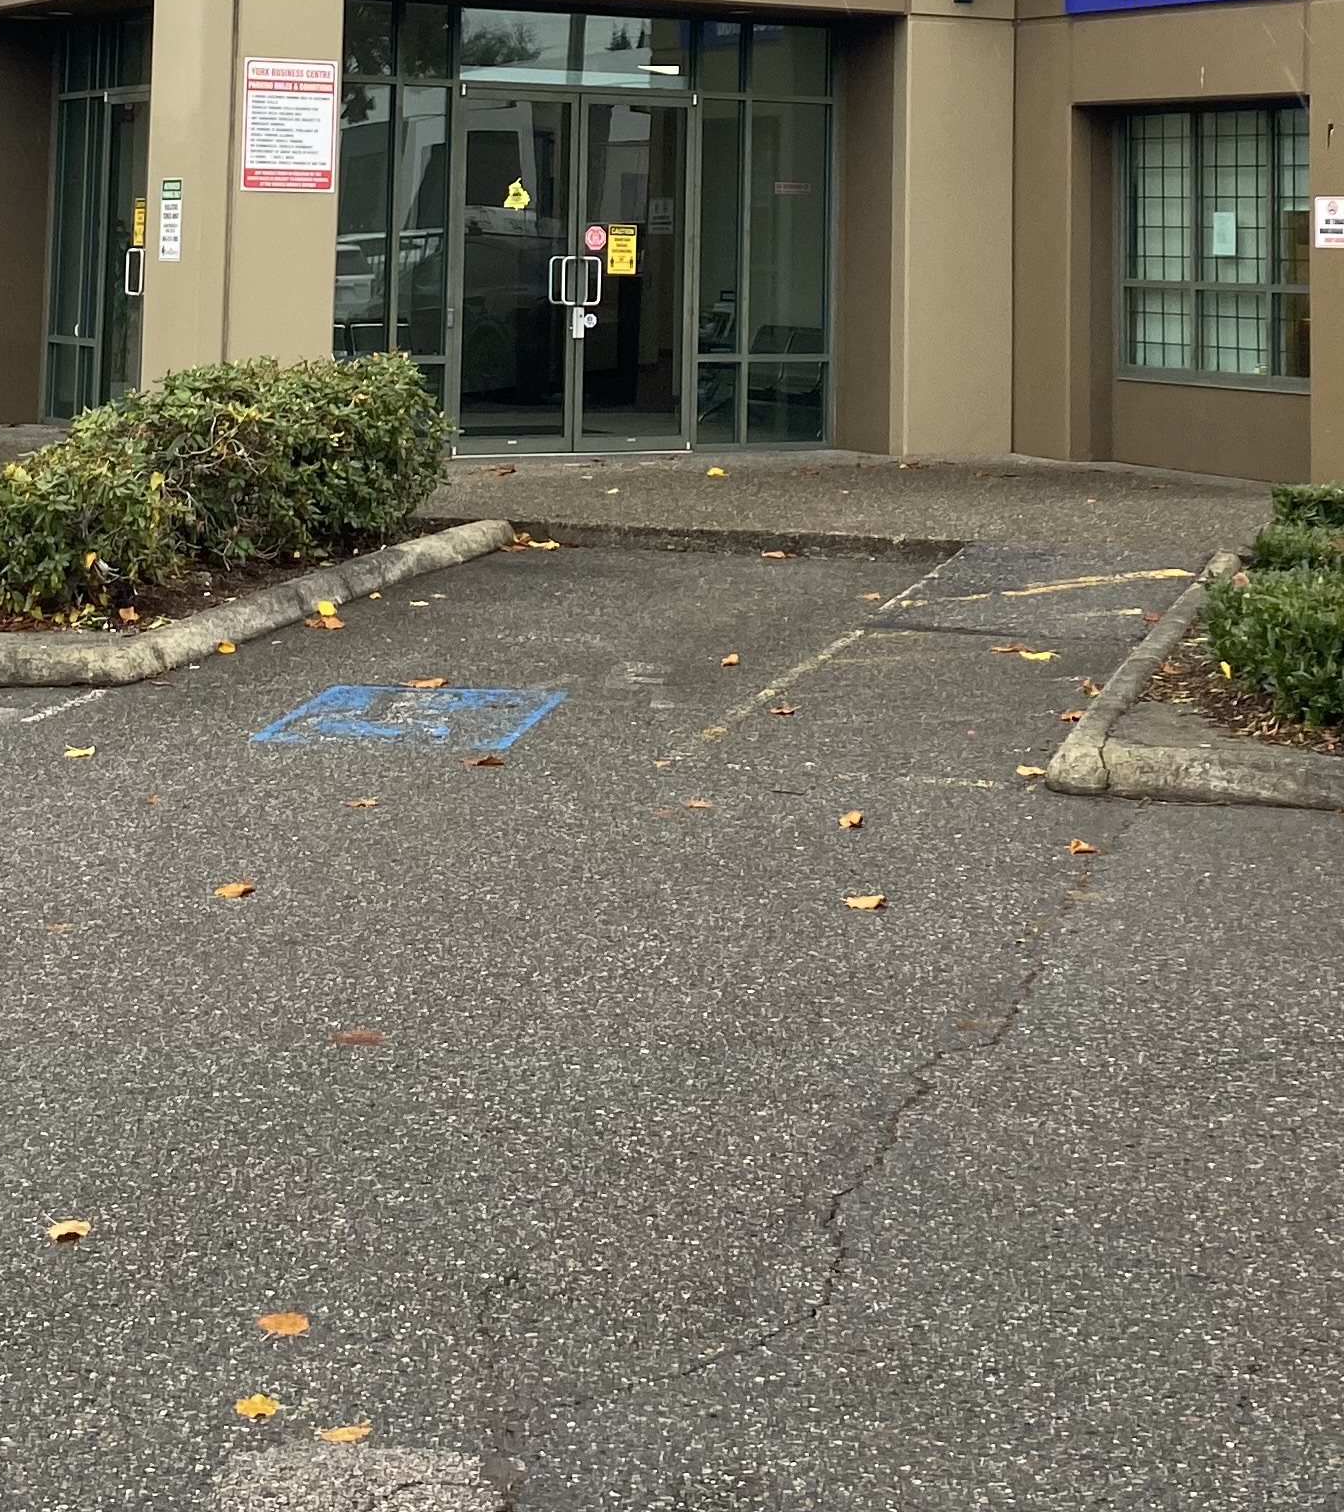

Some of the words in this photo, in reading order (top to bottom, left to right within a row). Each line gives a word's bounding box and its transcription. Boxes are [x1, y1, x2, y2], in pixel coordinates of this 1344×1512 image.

[251, 67, 270, 77] YORK
[271, 68, 304, 78] BUSINESS
[305, 69, 332, 79] CENTRE
